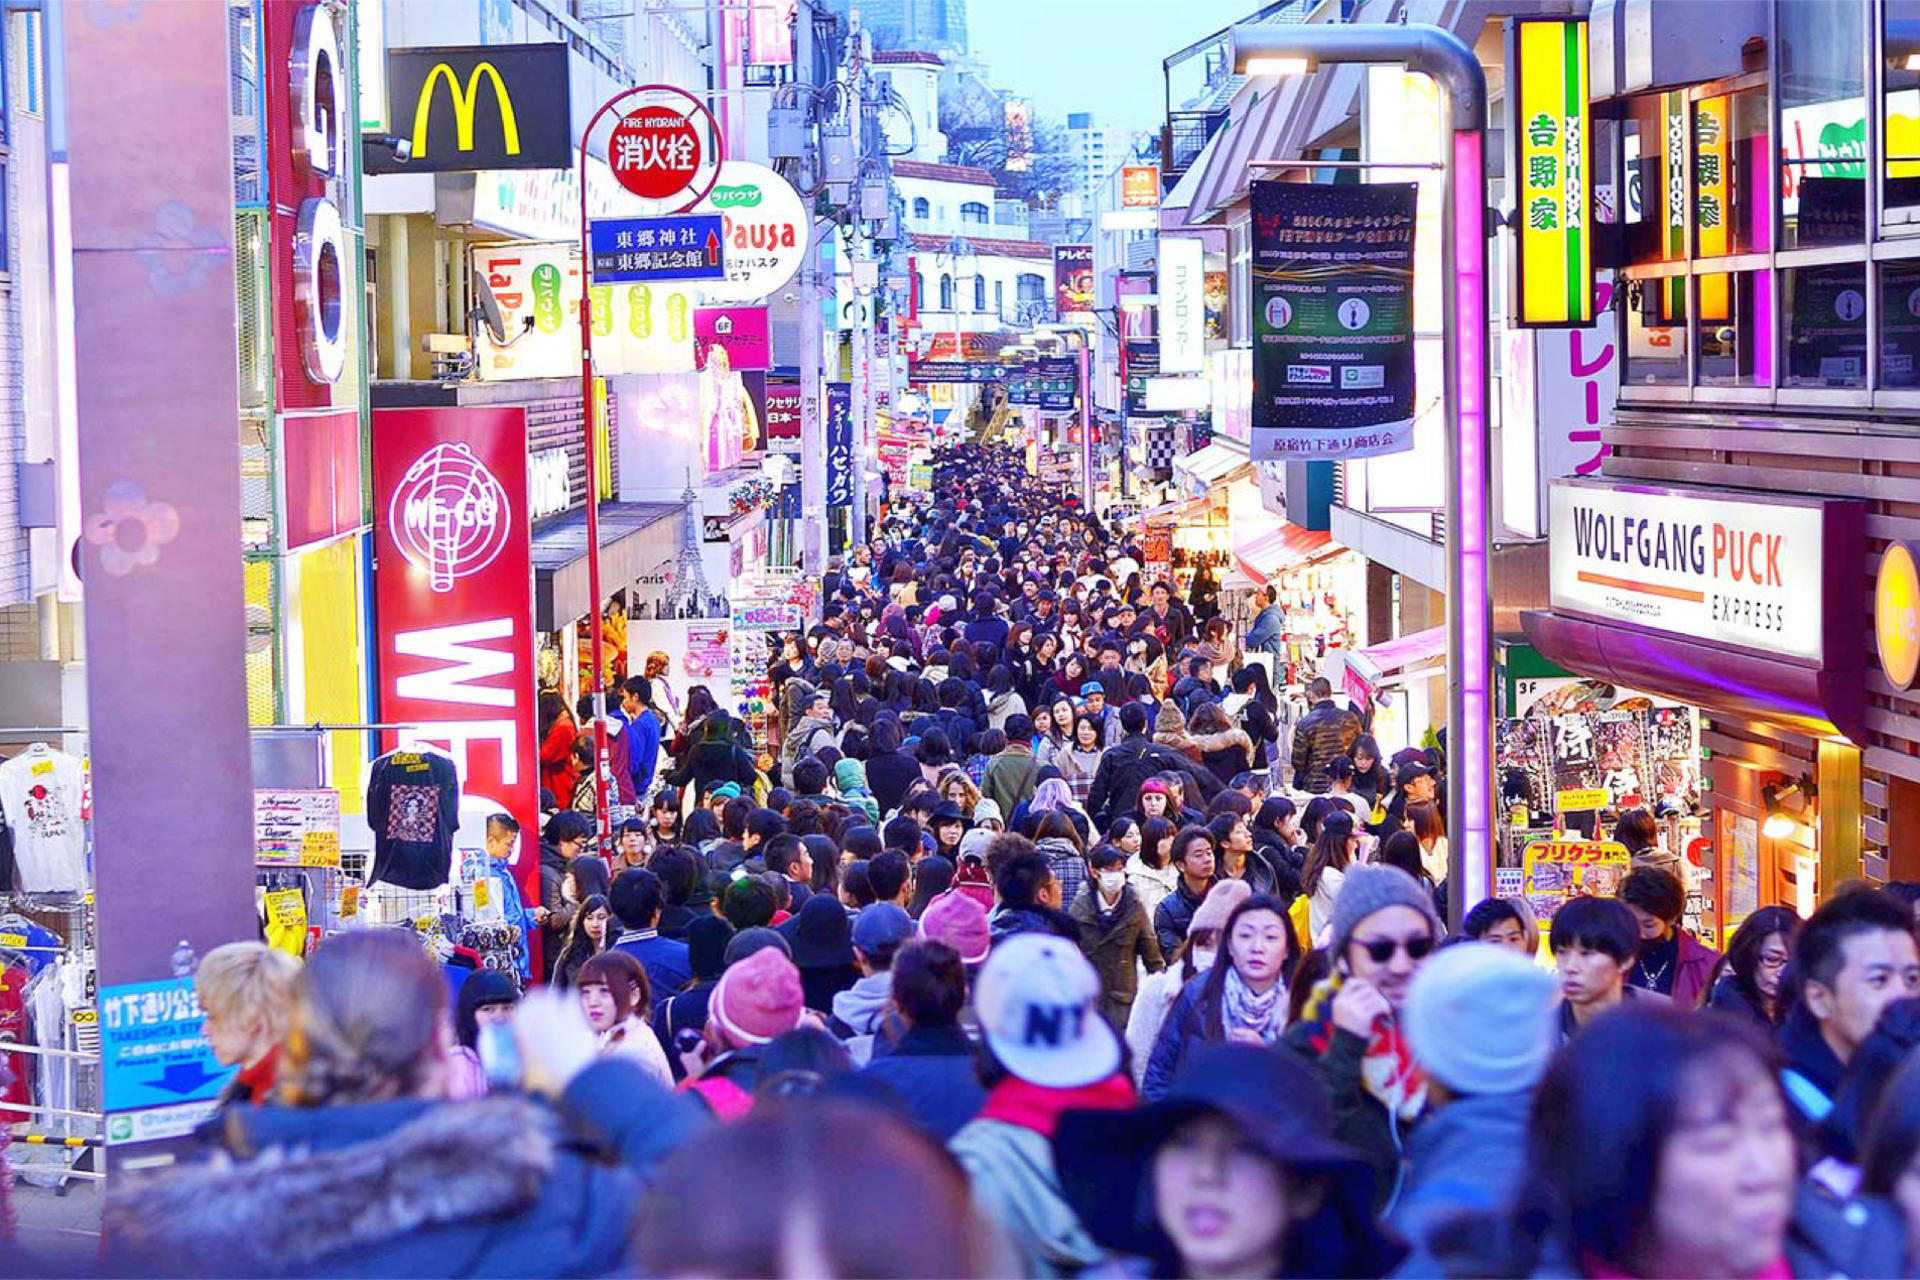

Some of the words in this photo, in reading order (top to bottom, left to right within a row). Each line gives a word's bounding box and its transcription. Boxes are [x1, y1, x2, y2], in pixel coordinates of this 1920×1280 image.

[623, 117, 642, 128] FIRE
[645, 116, 686, 128] HYDRANT
[616, 133, 695, 171] 消火栓
[1528, 114, 1558, 230] 吉野家
[1565, 116, 1581, 228] YOSHINOYA
[616, 228, 698, 249] 東郷神社
[617, 250, 703, 272] 東郷記念館
[489, 258, 521, 288] La
[718, 322, 730, 331] 6F
[768, 412, 801, 424] 日本一
[1273, 432, 1394, 453] 原宿竹下通り商店会
[1573, 506, 1705, 575] WOLFGANG
[1713, 522, 1784, 588] PUCK
[635, 574, 664, 585] Paris
[1711, 594, 1784, 632] EXPRESS
[1519, 682, 1537, 694] 3F
[1533, 844, 1604, 862] プリクラ
